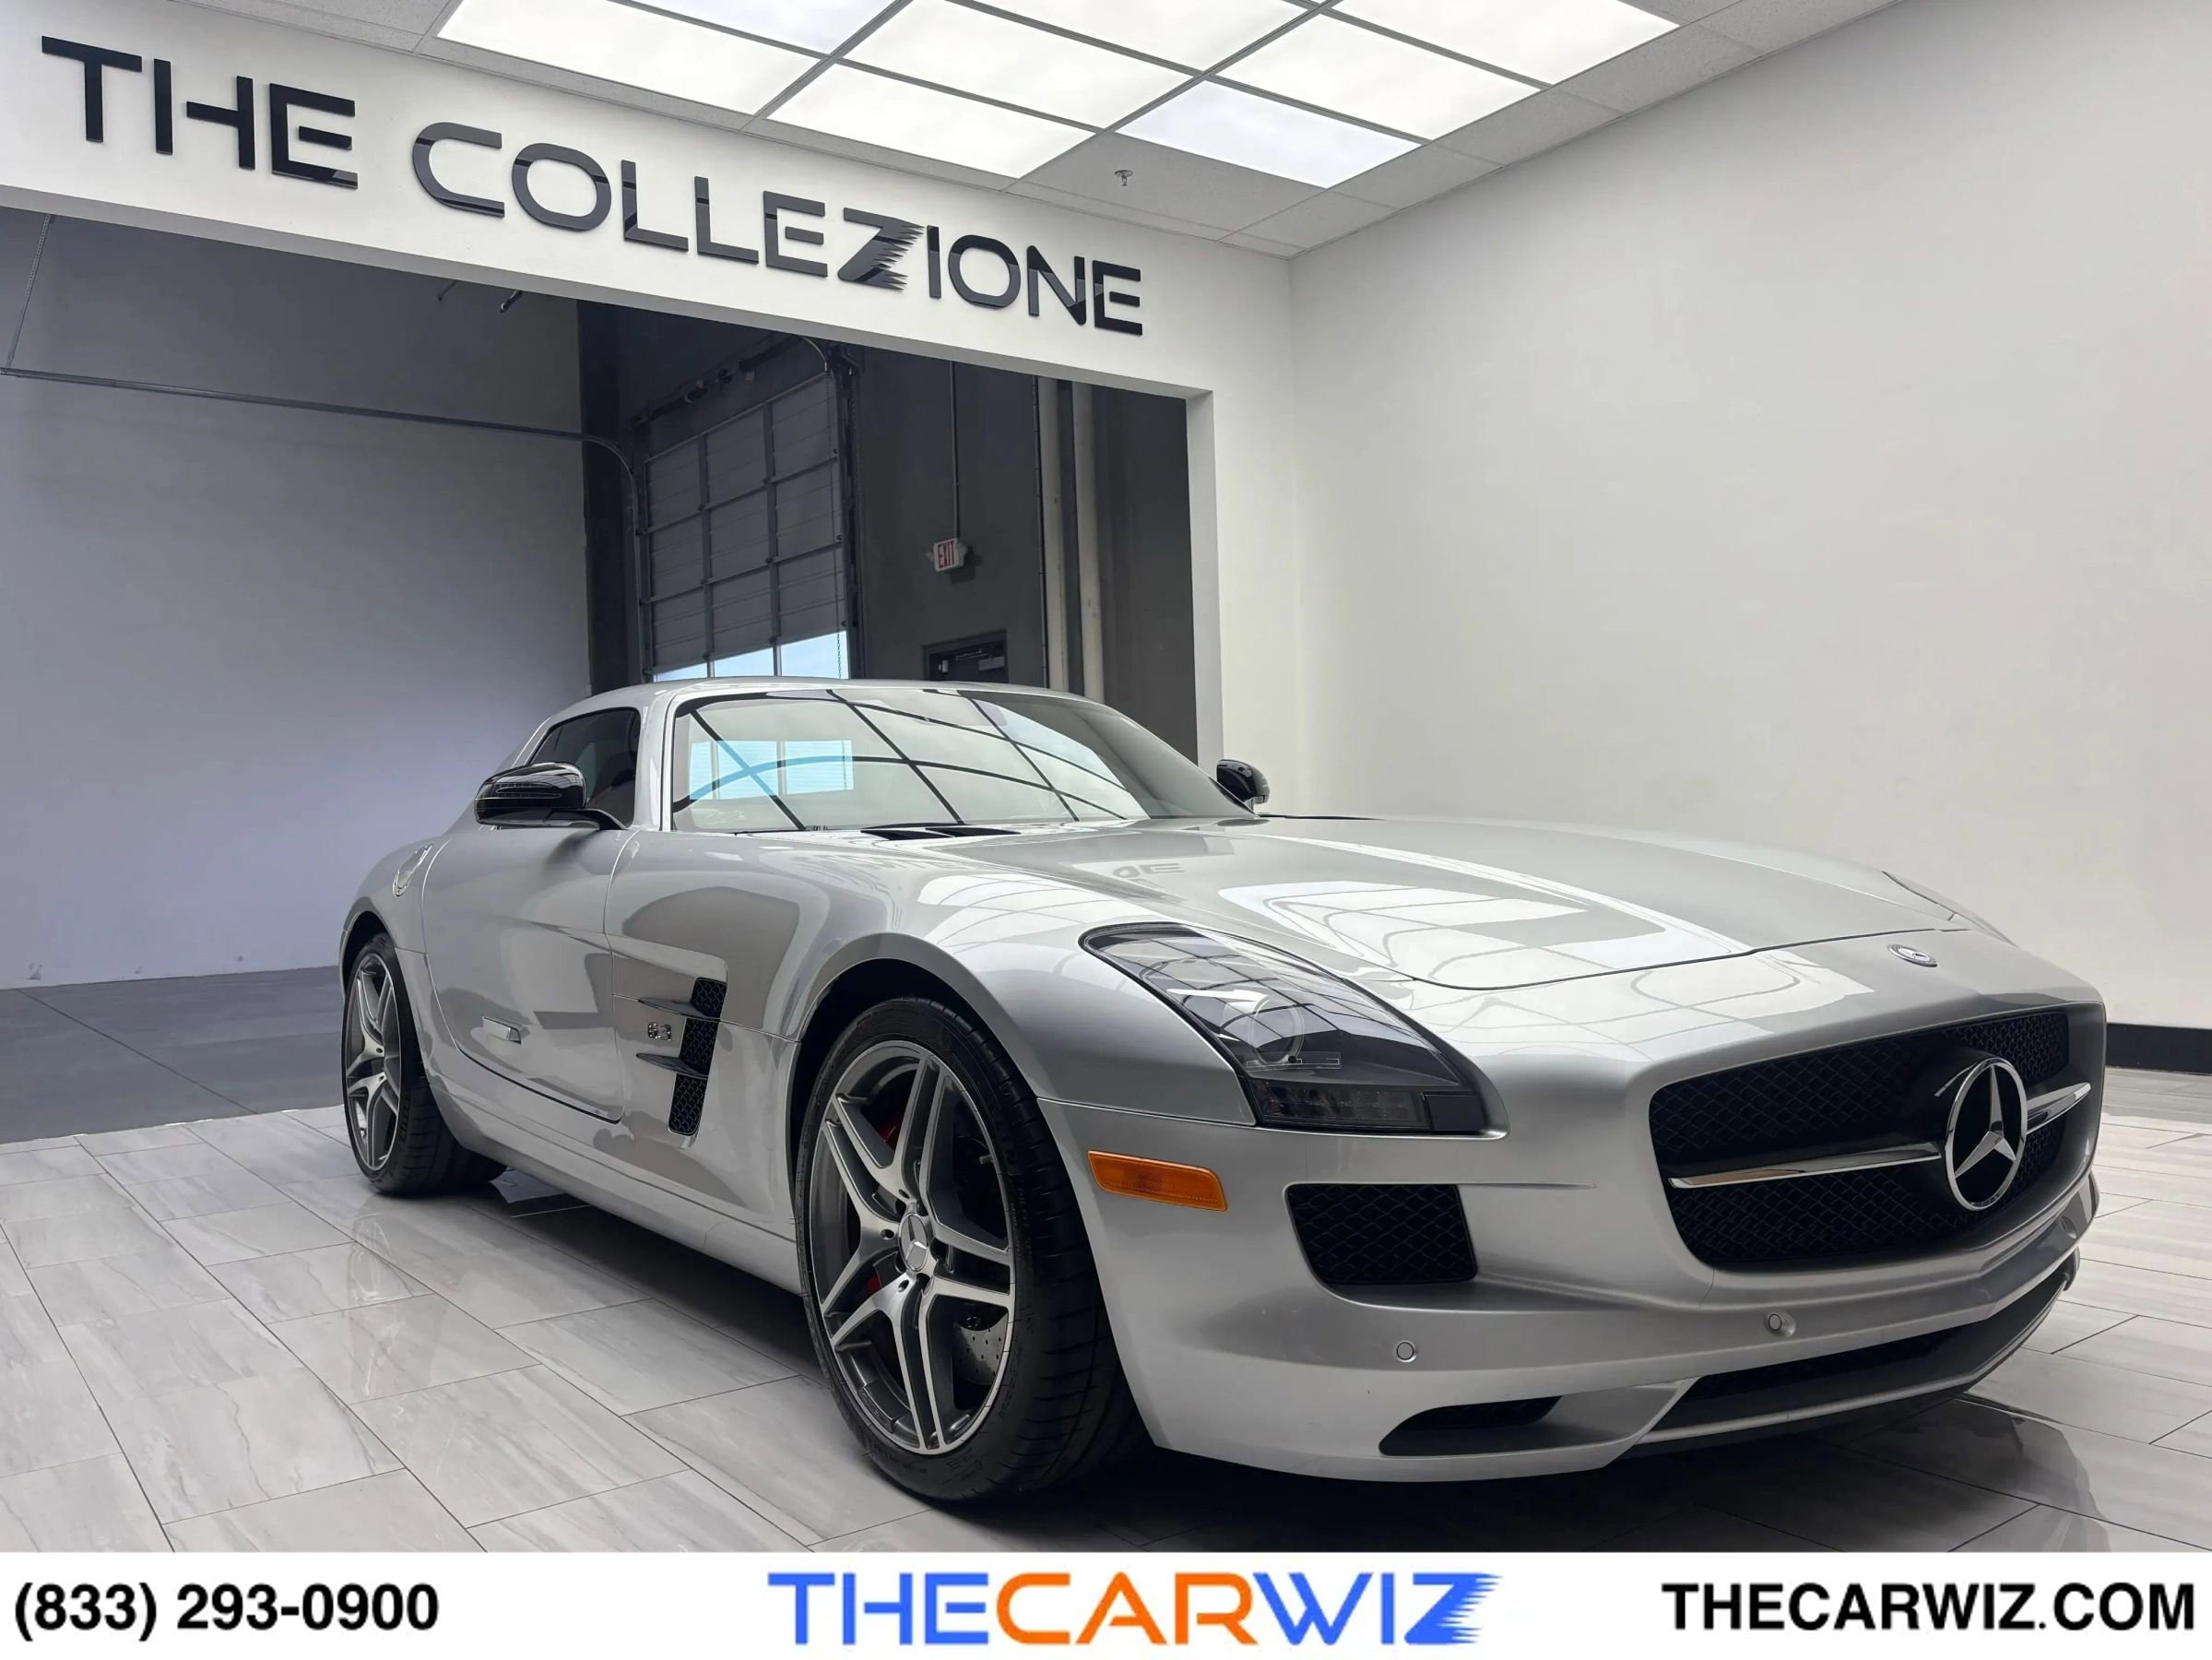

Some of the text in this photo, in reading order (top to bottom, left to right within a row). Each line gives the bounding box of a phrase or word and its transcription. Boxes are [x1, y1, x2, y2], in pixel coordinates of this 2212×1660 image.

[41, 35, 1143, 337] THE COLLEZIONE
[937, 540, 955, 569] EXIT
[647, 1021, 672, 1041] 6.3
